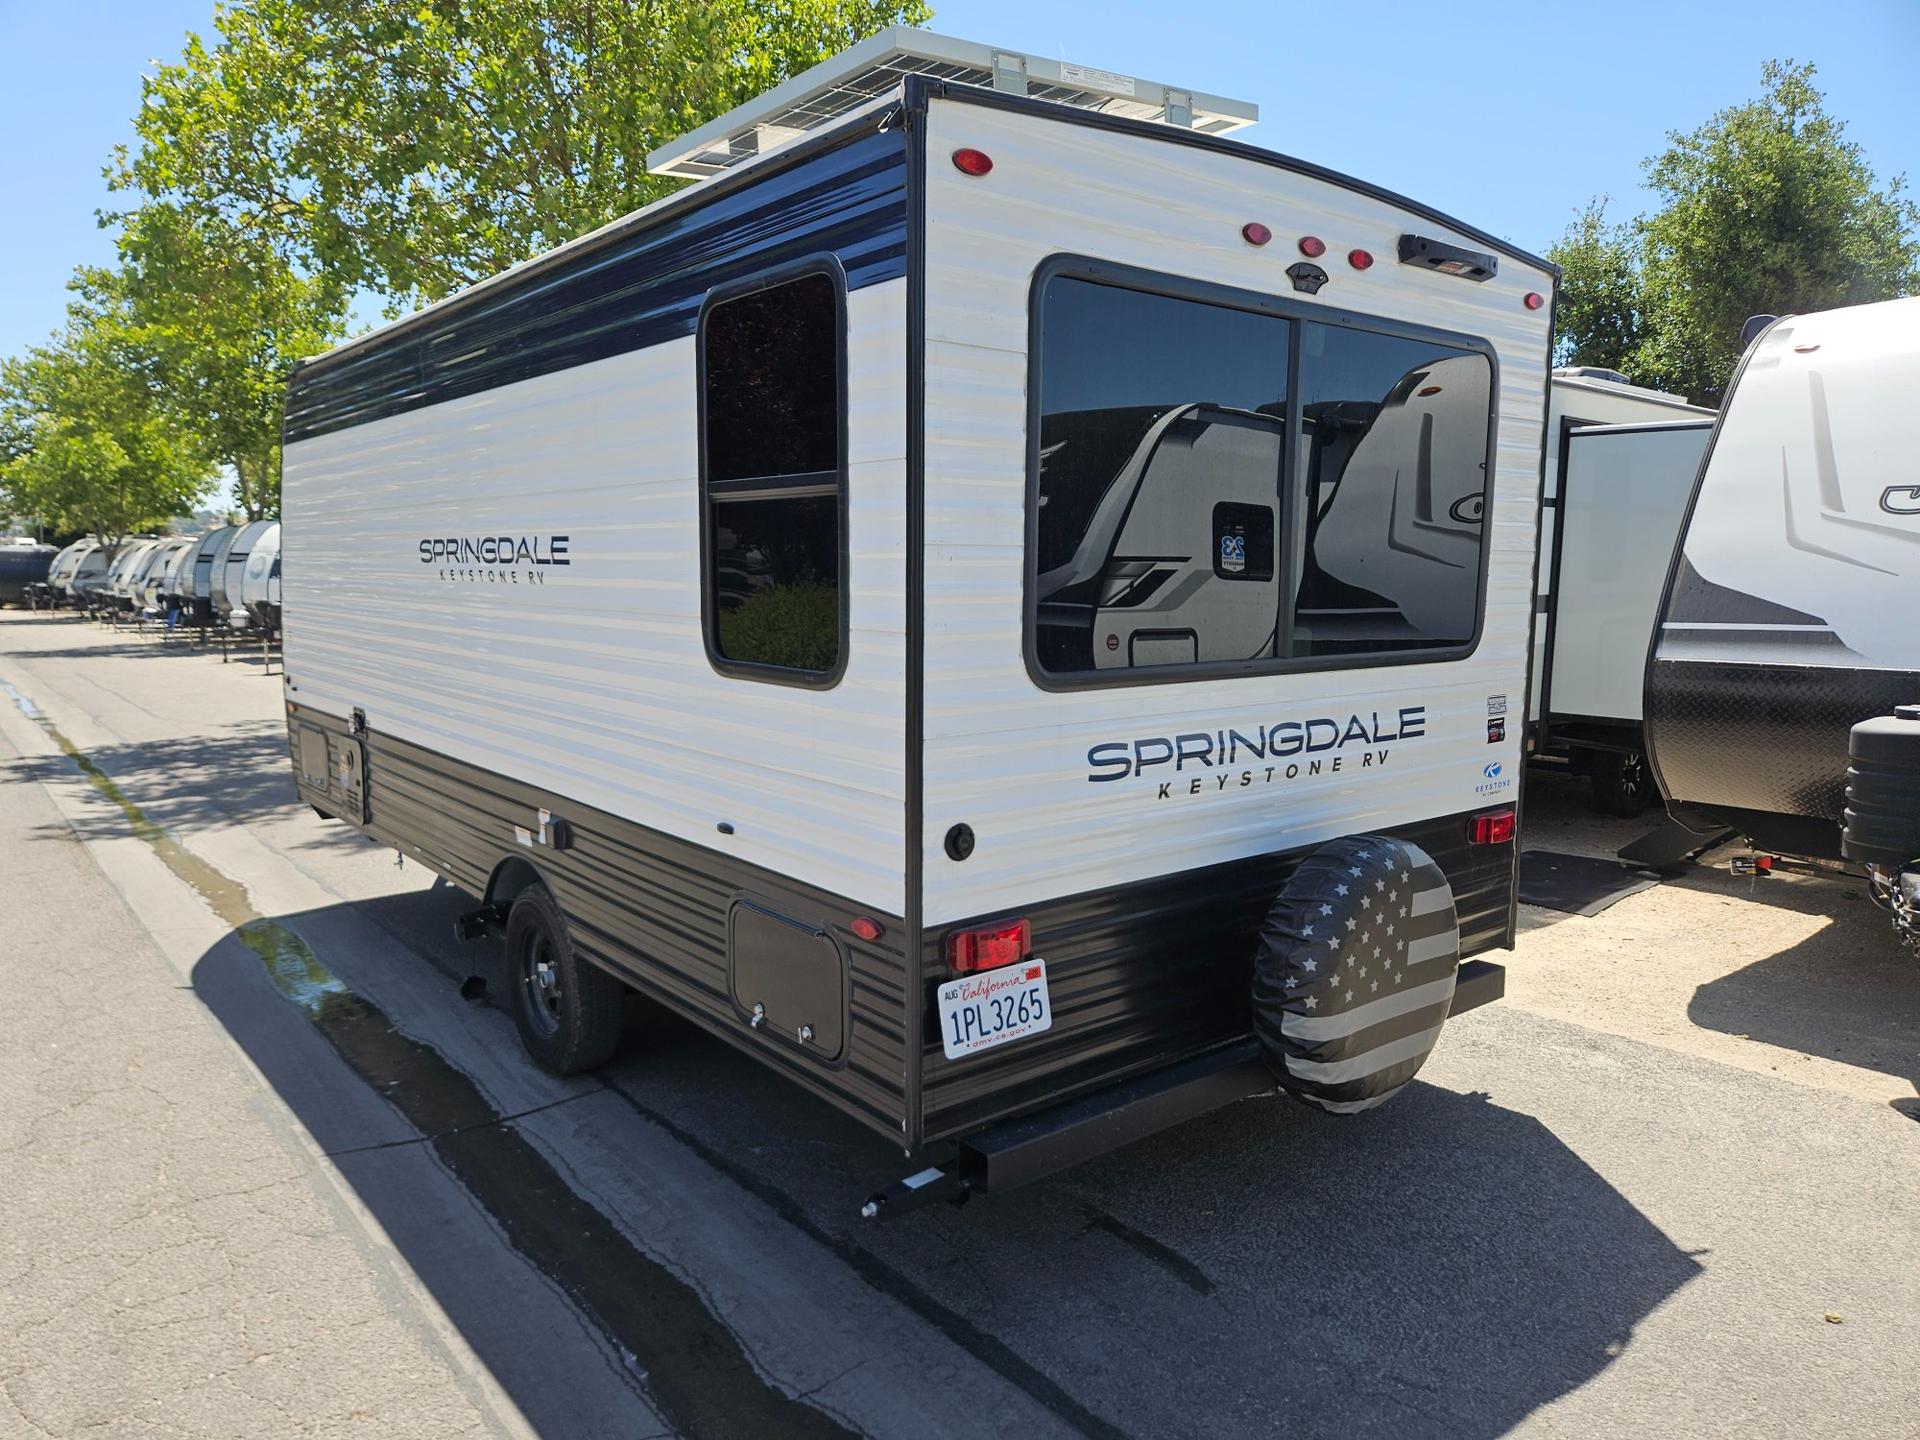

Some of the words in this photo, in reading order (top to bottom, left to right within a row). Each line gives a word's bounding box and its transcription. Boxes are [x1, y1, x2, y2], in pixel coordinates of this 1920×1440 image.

[419, 535, 570, 566] SPRINGDALE
[440, 569, 518, 584] KEYSTONE
[528, 571, 544, 585] RV
[1088, 706, 1426, 783] SPRINGDALE
[1158, 757, 1343, 800] KEYSTONE
[1363, 750, 1390, 768] RV
[1475, 780, 1510, 793] KEYSTONE
[944, 988, 959, 1001] AUG
[962, 974, 1027, 1001] California
[950, 988, 1043, 1046] 1PL3265
[972, 1026, 1026, 1048] dmv.ca.gov
